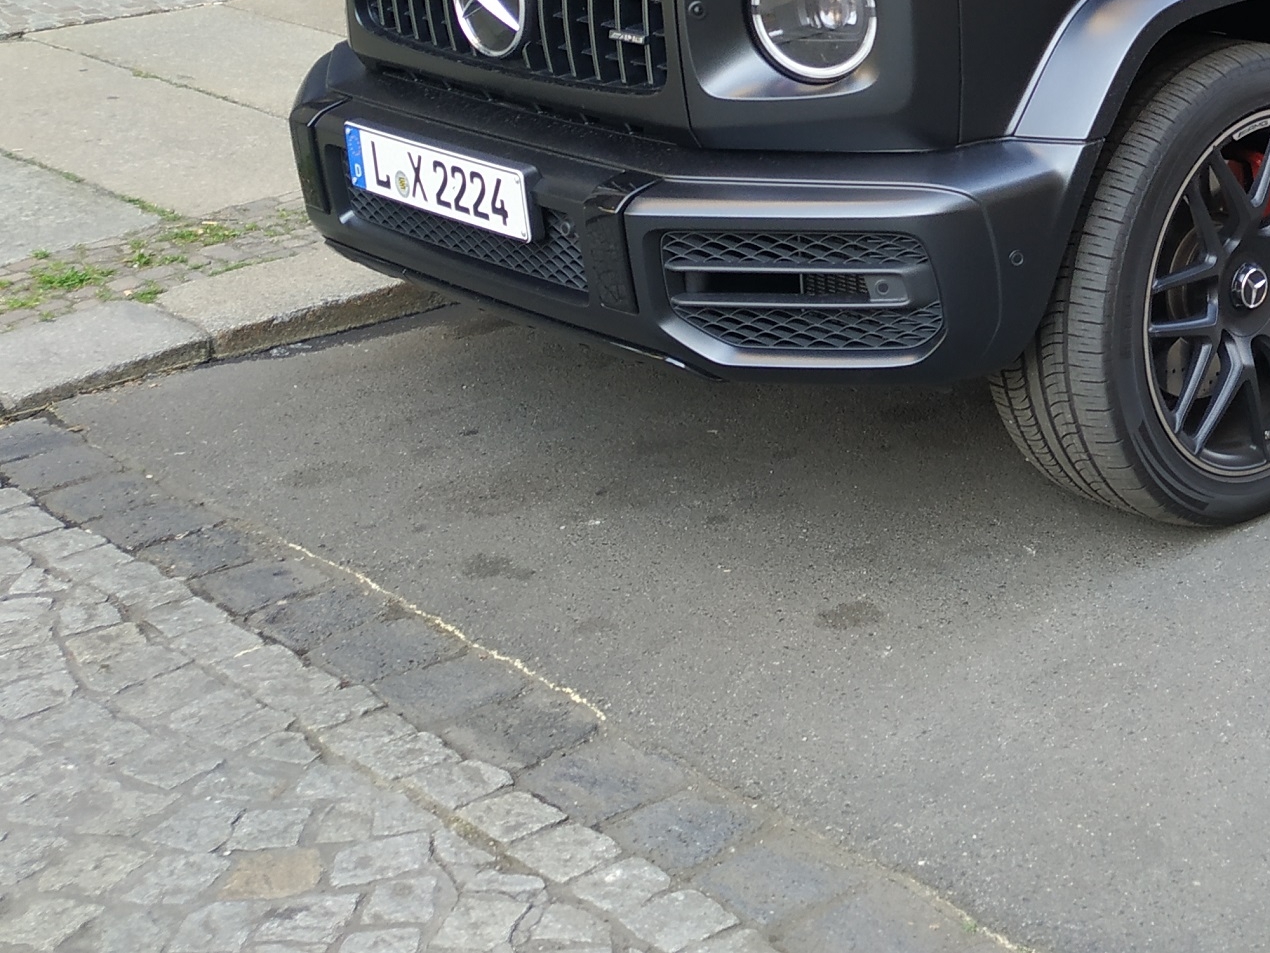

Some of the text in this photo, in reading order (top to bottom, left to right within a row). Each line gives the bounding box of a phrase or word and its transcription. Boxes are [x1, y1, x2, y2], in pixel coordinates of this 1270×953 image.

[354, 163, 362, 178] D
[370, 140, 510, 227] L X 2224
